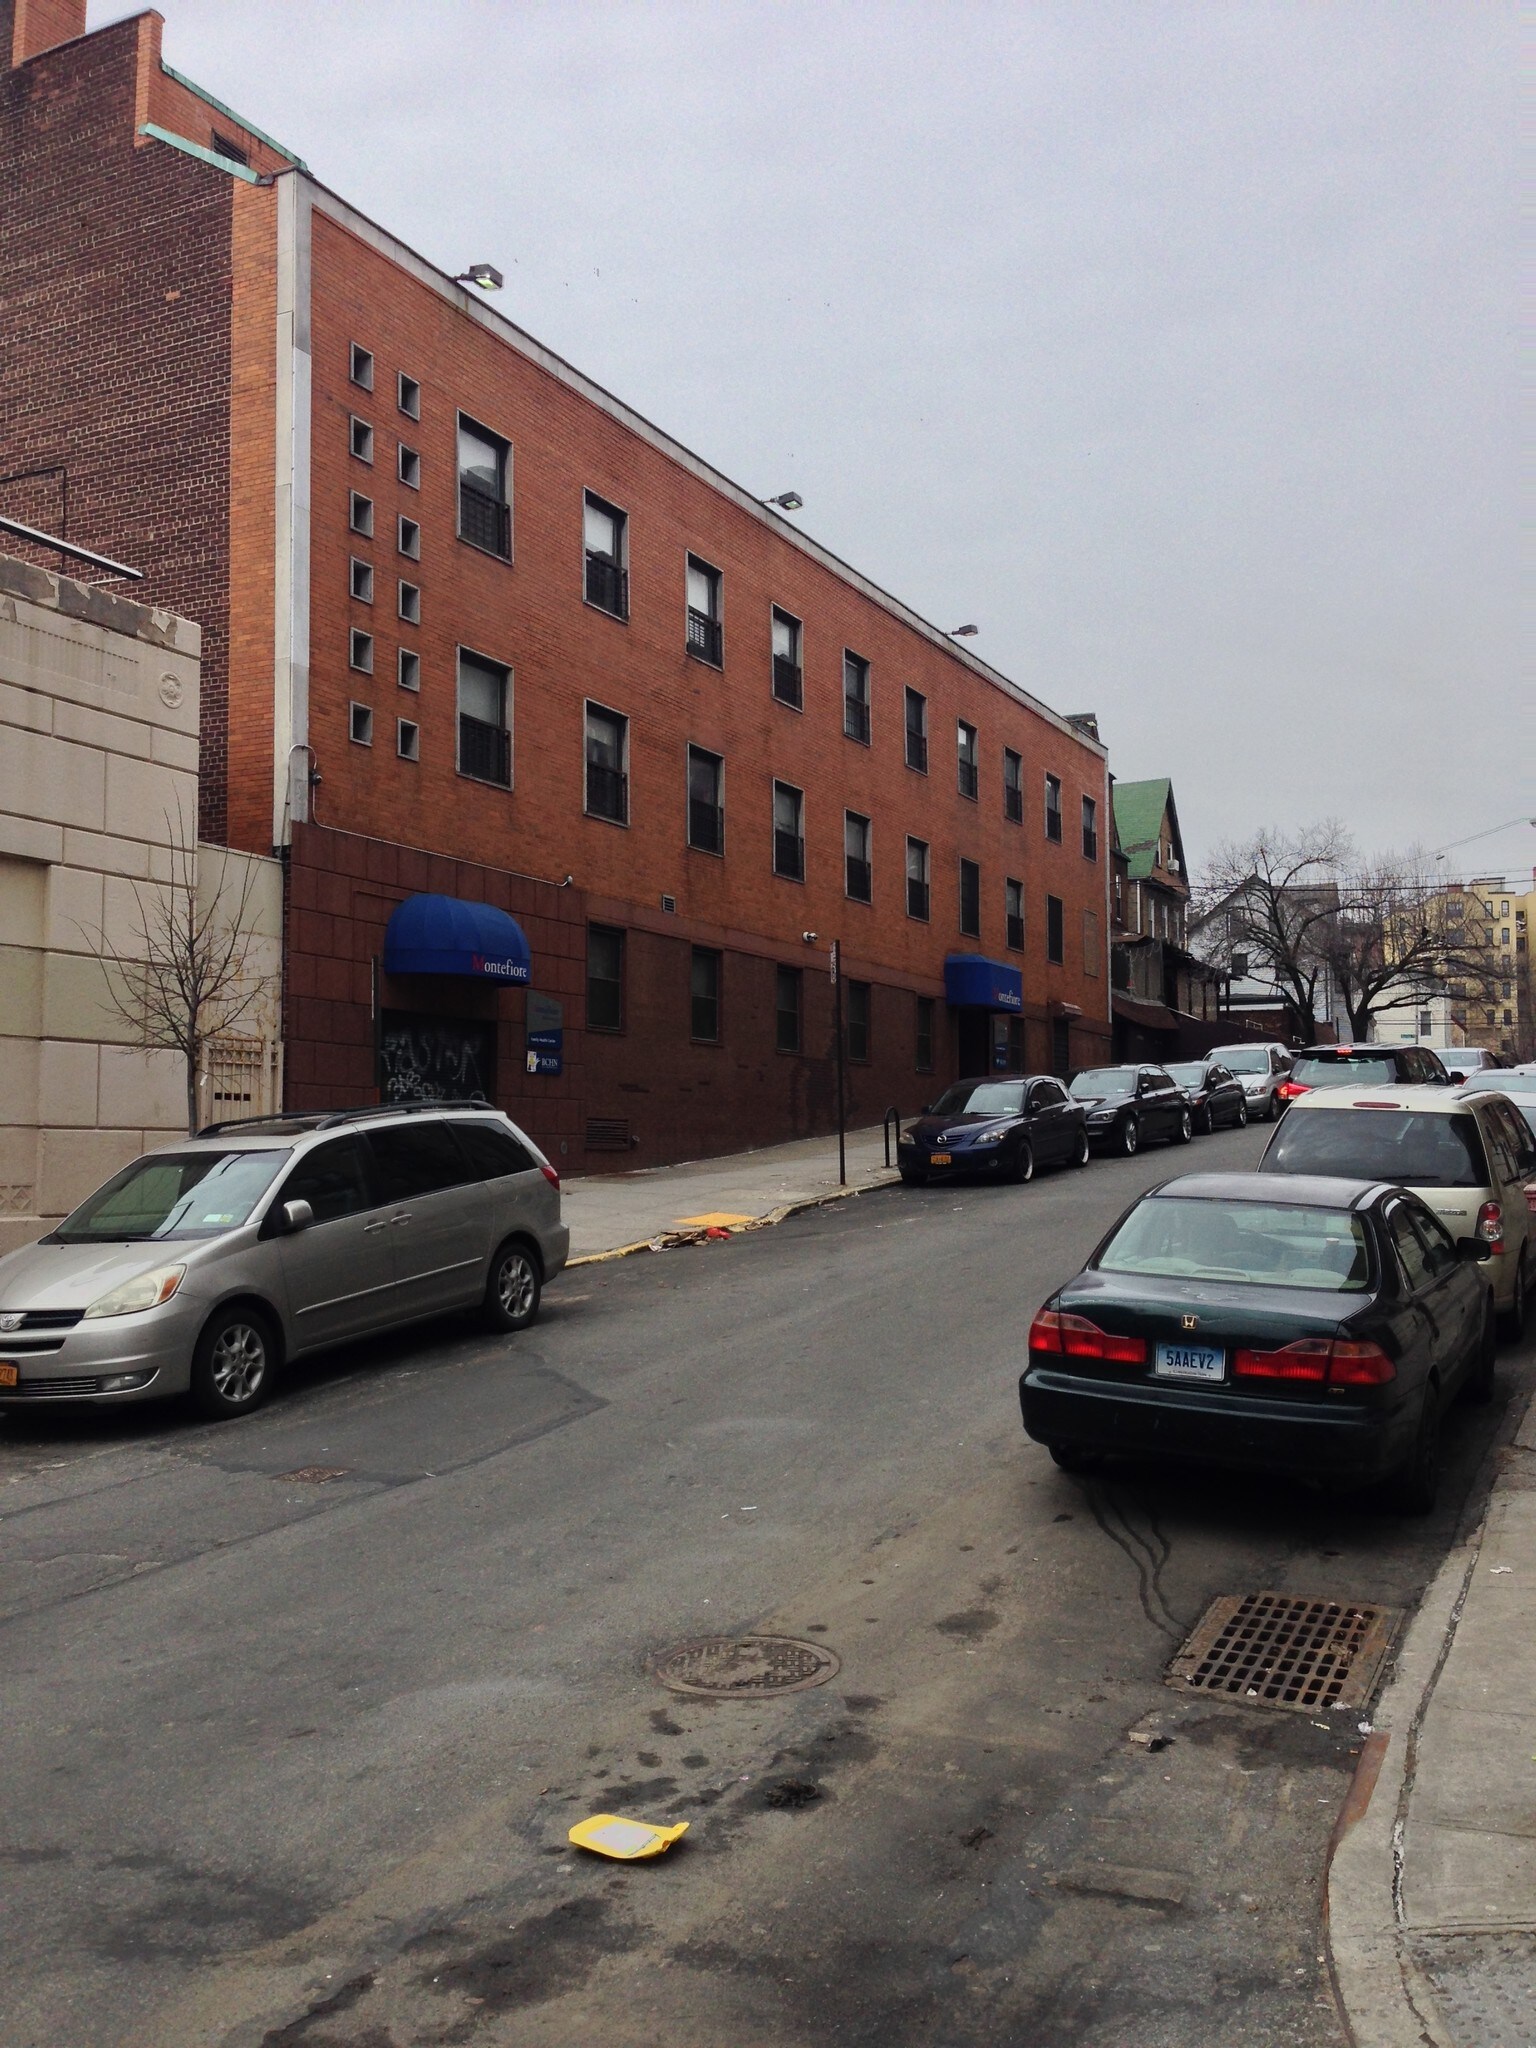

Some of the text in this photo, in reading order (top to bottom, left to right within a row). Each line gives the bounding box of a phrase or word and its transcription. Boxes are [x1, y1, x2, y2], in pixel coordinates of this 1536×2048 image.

[472, 952, 527, 977] Montefiore
[541, 1057, 558, 1067] BCHN
[1166, 1350, 1214, 1370] 5AAEV2
